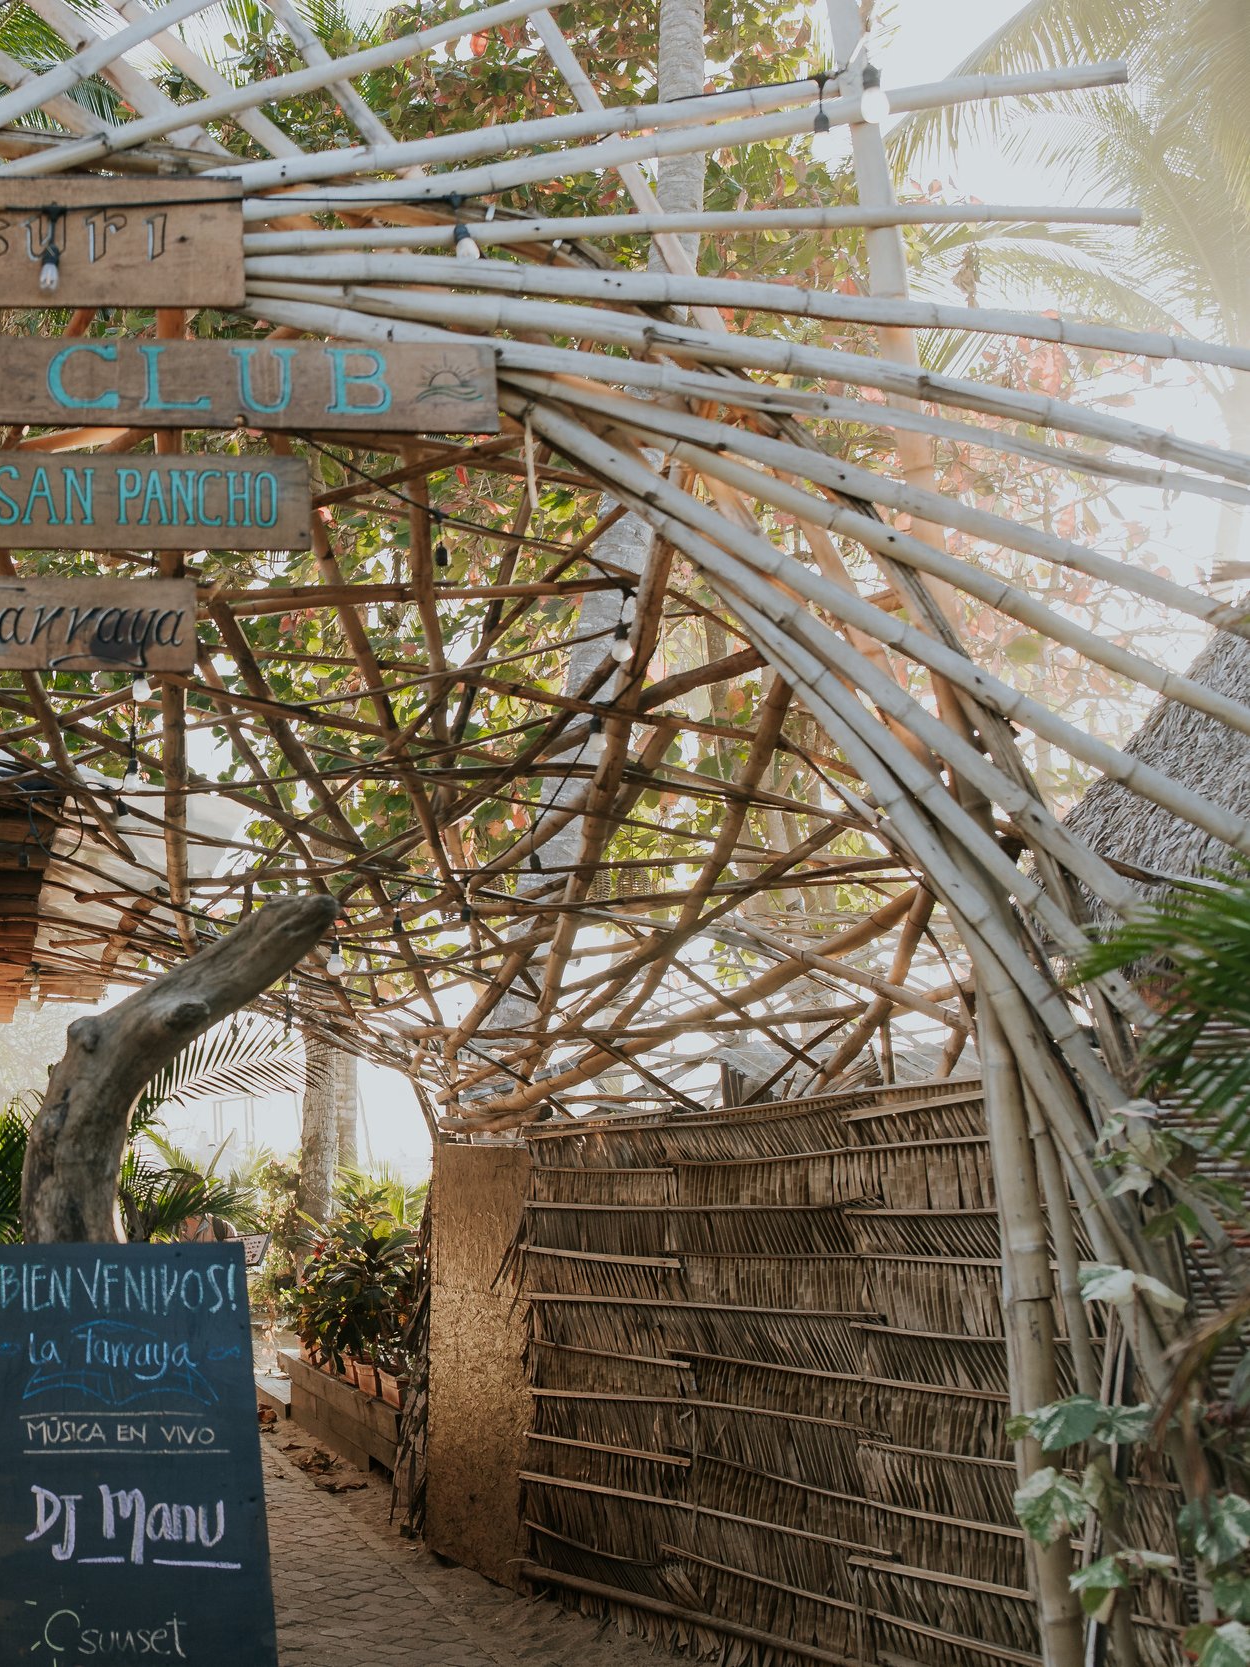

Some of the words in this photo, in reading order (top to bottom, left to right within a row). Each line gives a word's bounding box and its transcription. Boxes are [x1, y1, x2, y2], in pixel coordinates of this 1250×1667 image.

[46, 343, 393, 415] CLUB
[115, 468, 279, 529] PANCHO
[77, 1326, 198, 1381] Tarraya
[26, 1416, 106, 1444] MÚSICA
[117, 1423, 147, 1443] EN
[161, 1424, 215, 1445] VIVO
[25, 1484, 83, 1561] DJ
